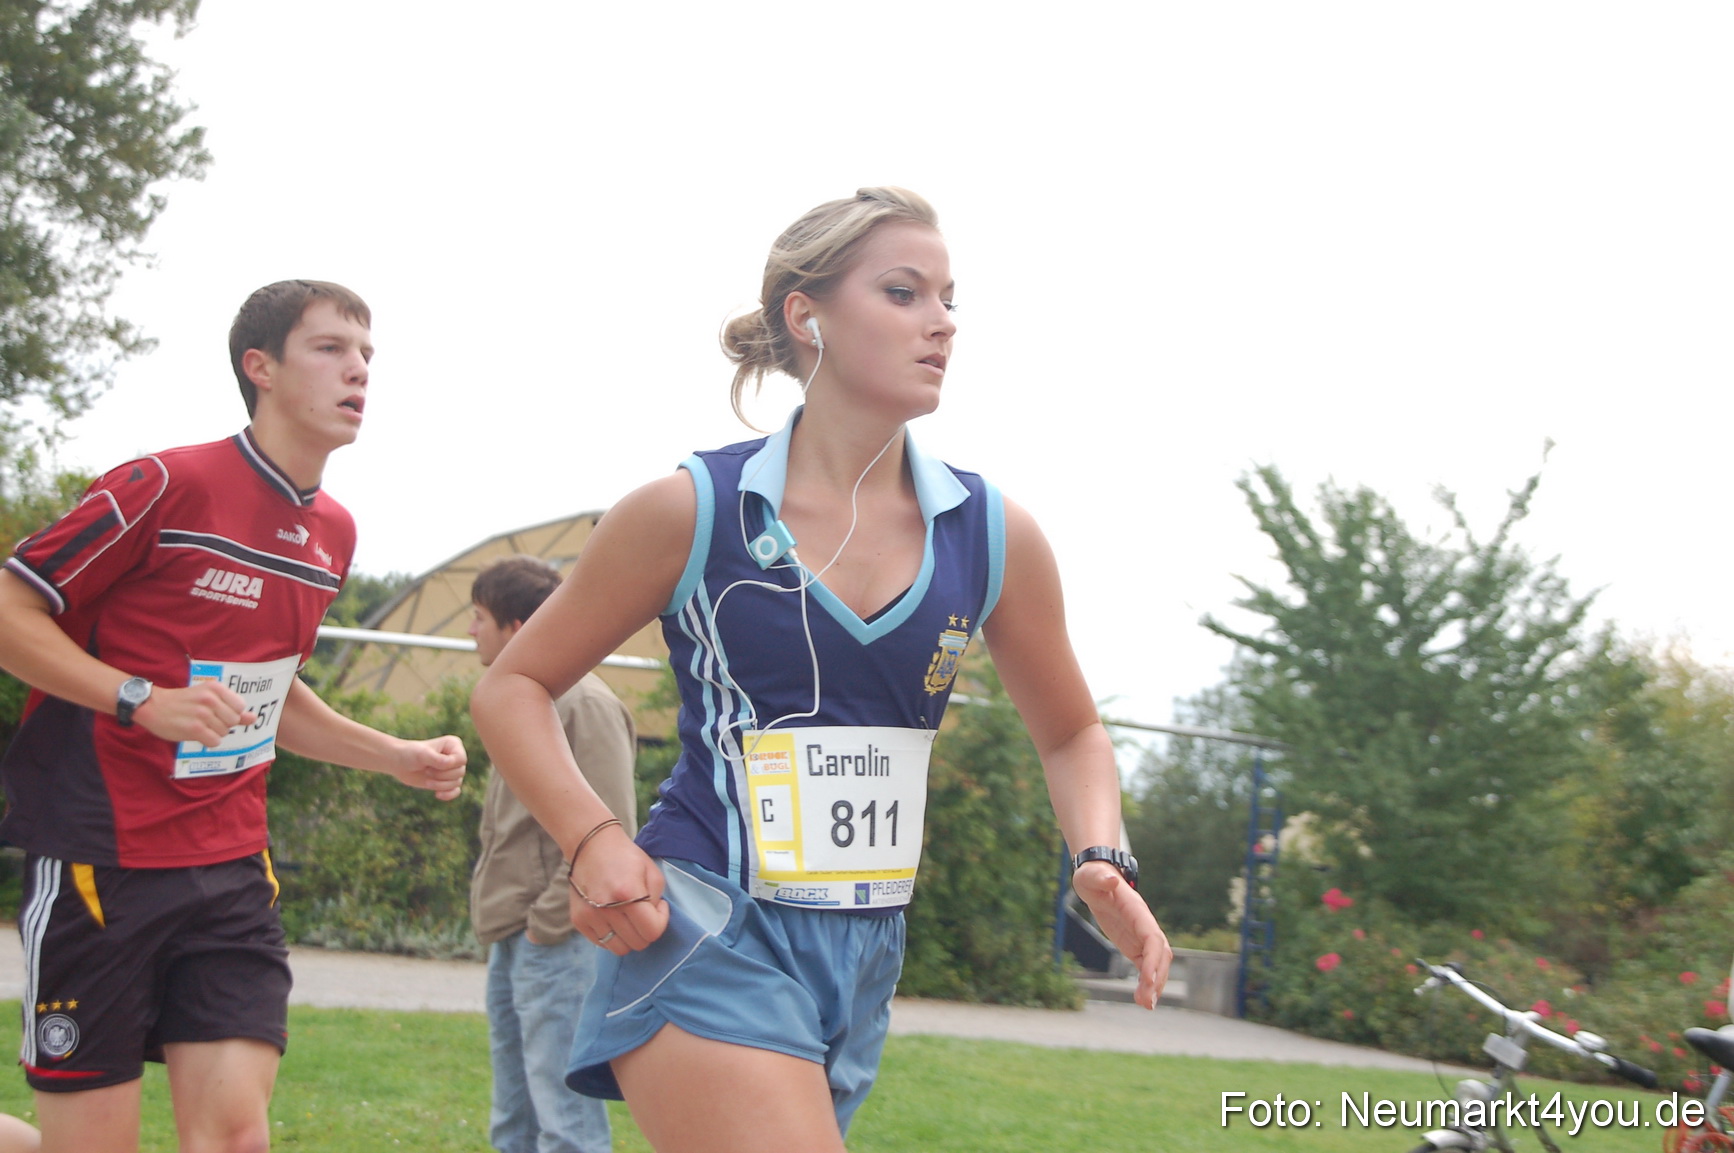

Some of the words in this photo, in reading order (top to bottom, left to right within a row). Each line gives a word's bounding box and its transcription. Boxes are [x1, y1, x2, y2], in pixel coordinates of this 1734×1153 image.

[195, 567, 265, 599] JURA
[228, 675, 273, 694] Florian
[806, 744, 890, 777] Carolin
[761, 798, 775, 823] C
[831, 800, 899, 848] 811
